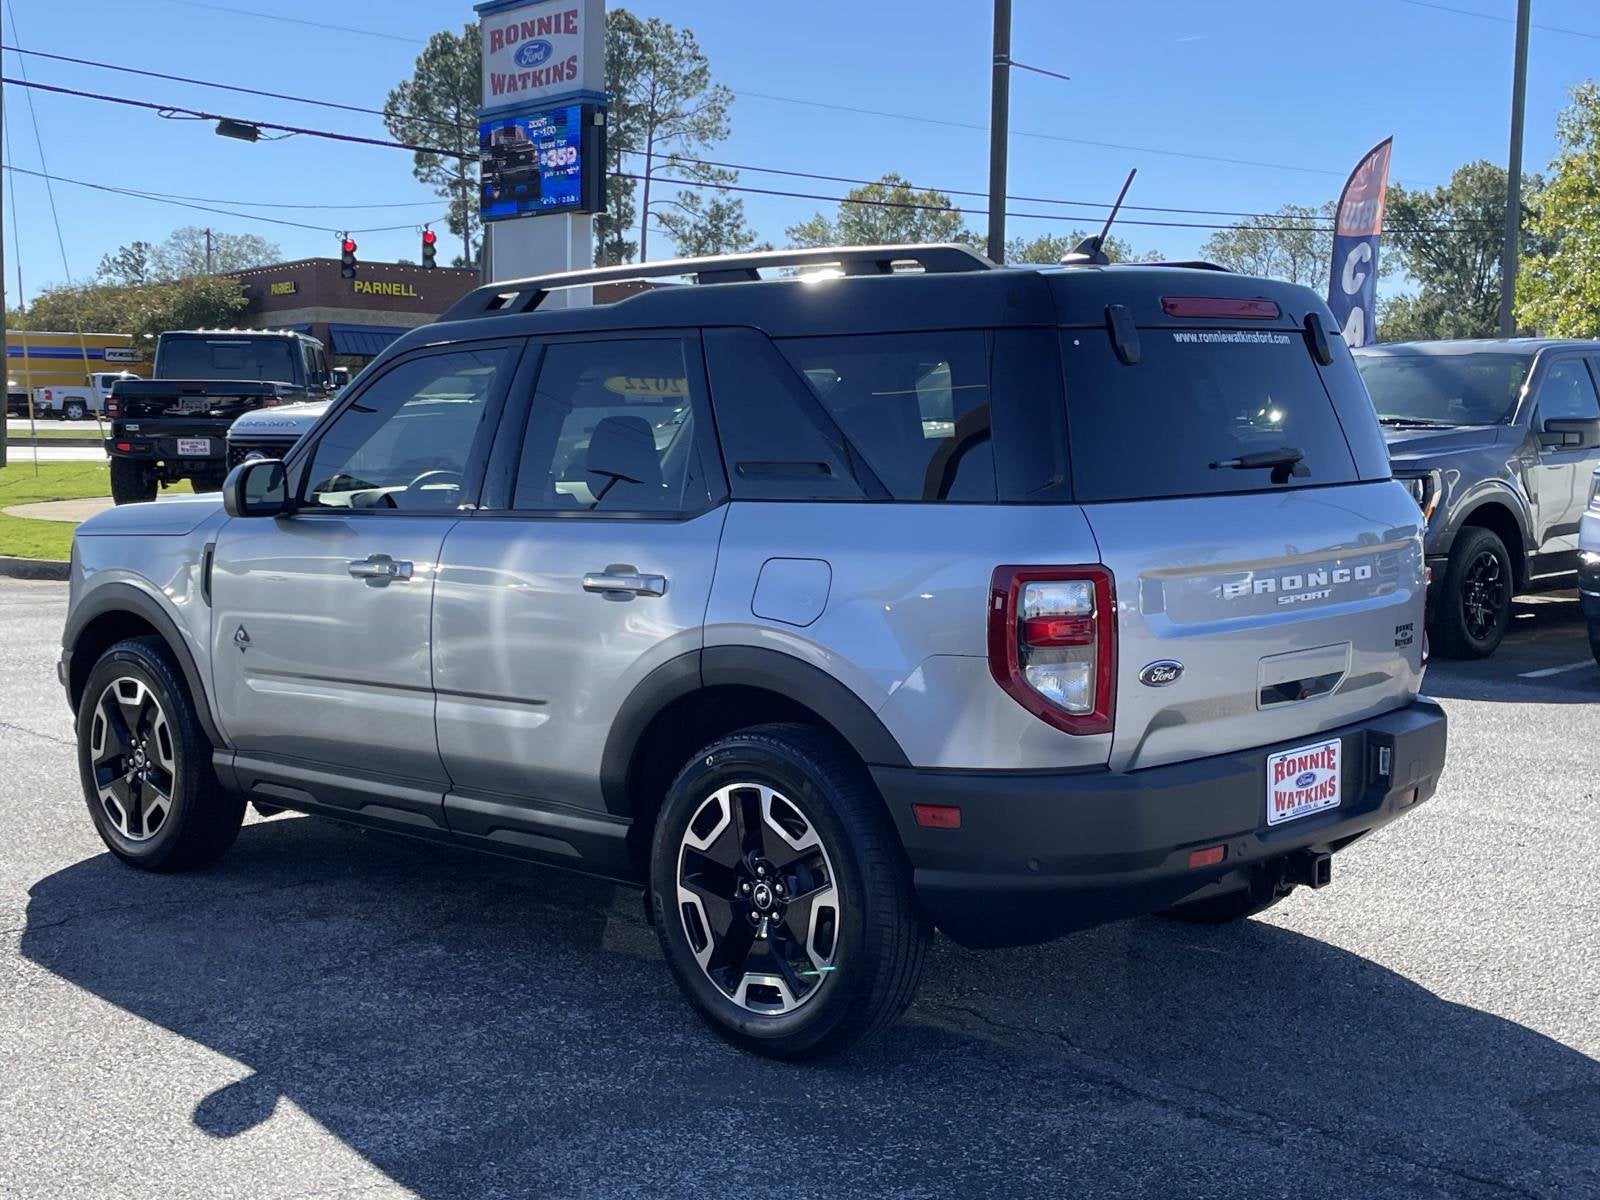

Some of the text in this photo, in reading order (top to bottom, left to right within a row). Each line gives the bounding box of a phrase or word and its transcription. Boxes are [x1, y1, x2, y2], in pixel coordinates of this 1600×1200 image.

[490, 9, 578, 54] RONNIE
[521, 44, 545, 65] Ford
[490, 55, 578, 95] WATKINS
[271, 281, 296, 295] PARNELL
[354, 280, 418, 297] PARNELL
[1173, 331, 1291, 344] www.ronniewatkinsford.com
[172, 398, 211, 412] Jeep
[1222, 565, 1372, 600] BRONCO
[1277, 589, 1332, 605] SPORT
[1151, 666, 1177, 682] Ford
[1274, 748, 1336, 785] RONNIE
[1274, 775, 1336, 812] WATKINS
